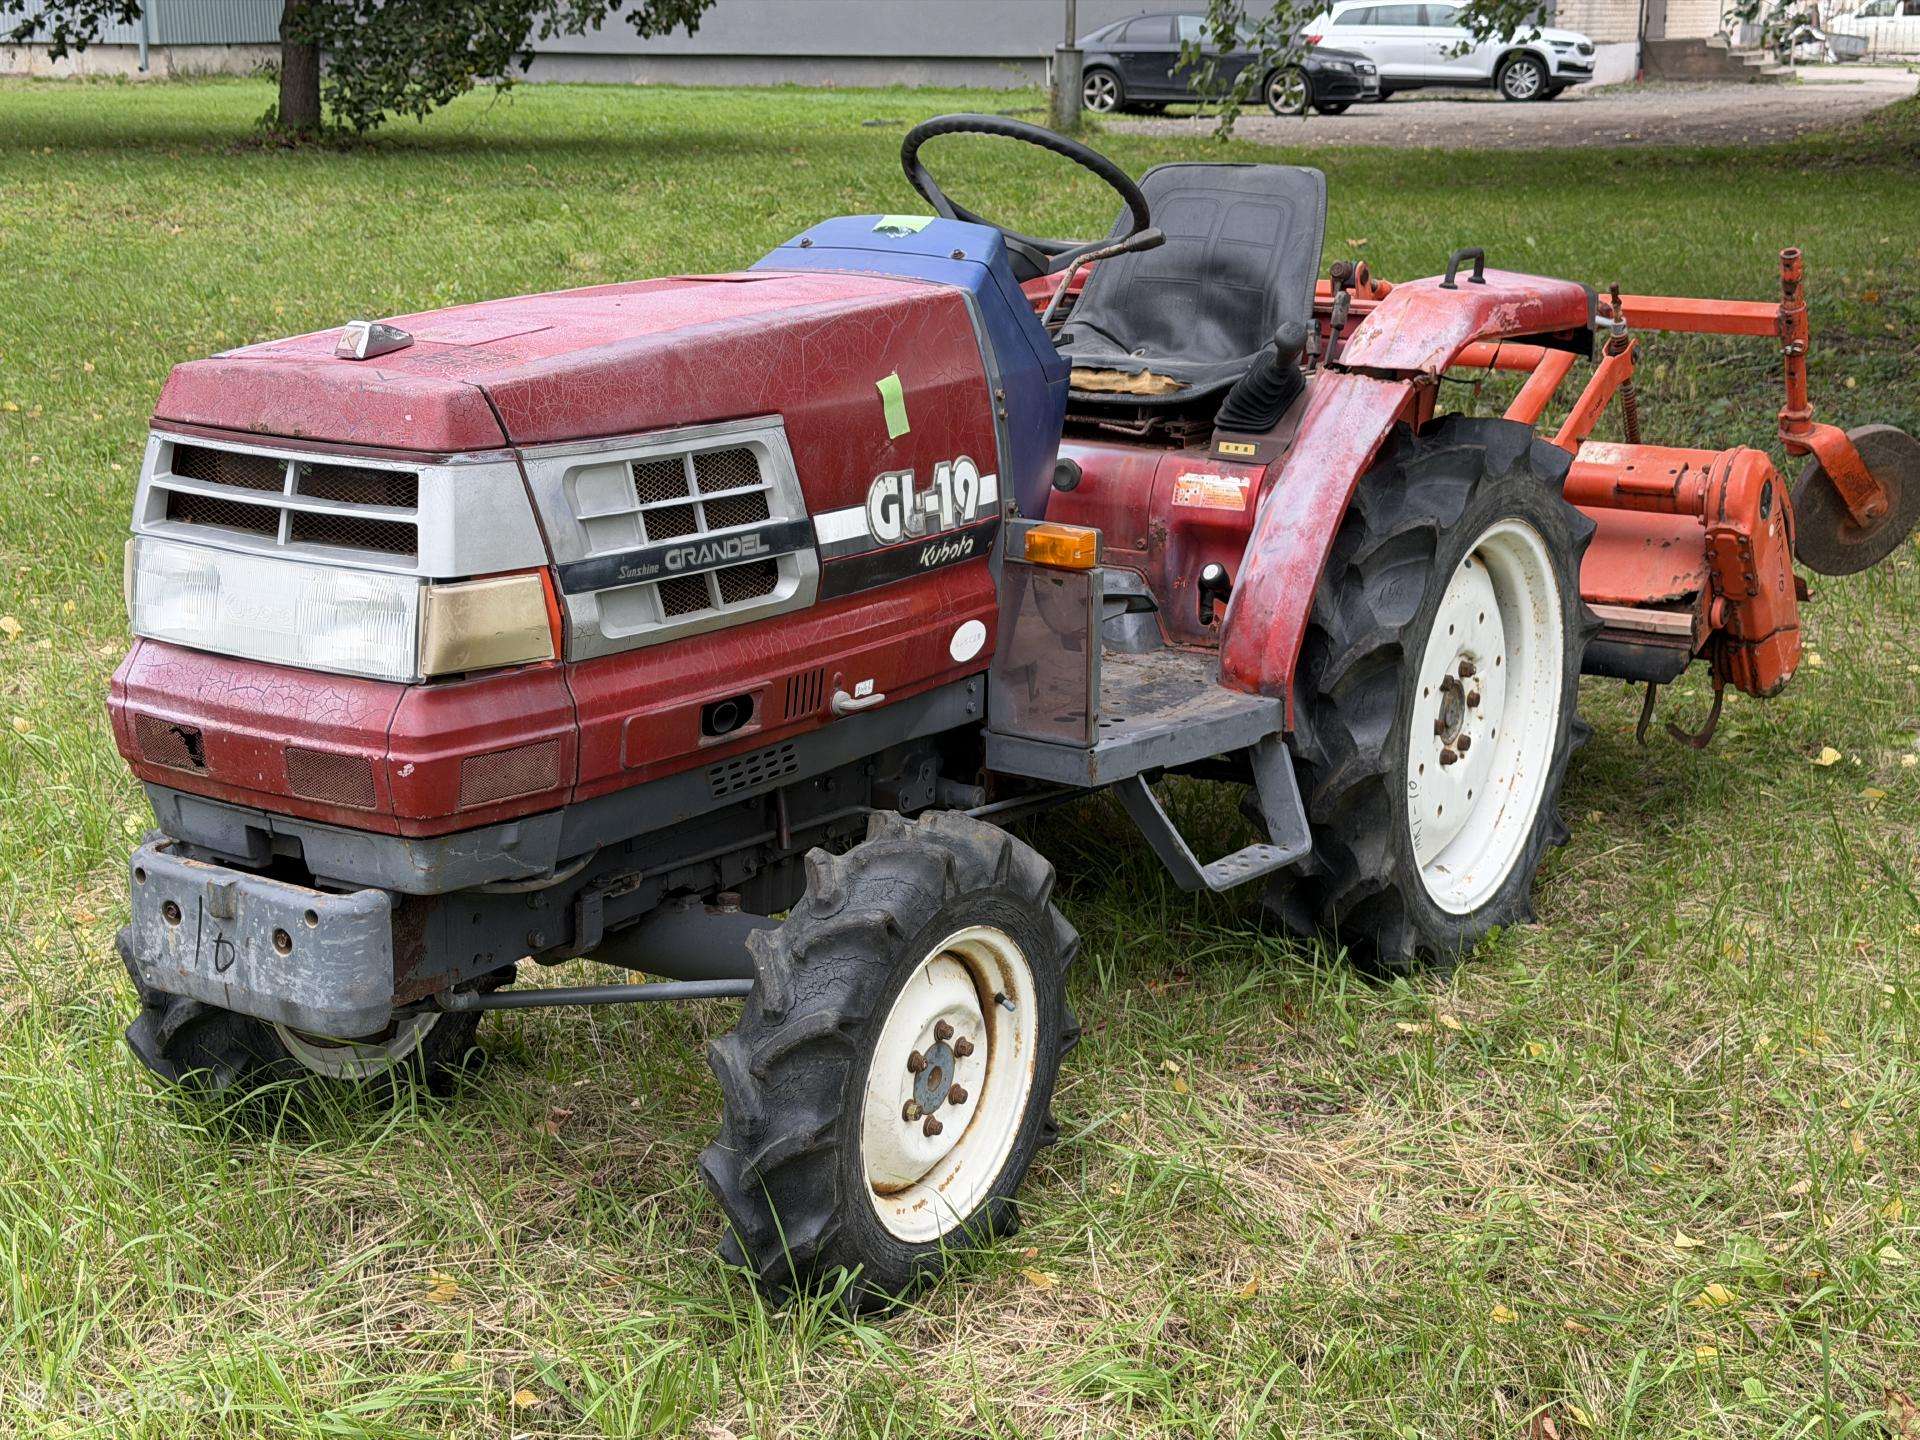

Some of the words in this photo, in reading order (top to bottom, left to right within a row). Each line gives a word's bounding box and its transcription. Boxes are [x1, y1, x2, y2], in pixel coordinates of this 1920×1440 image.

[867, 455, 980, 546] GL-19
[618, 564, 660, 579] Sunshine
[664, 533, 770, 571] GRANDEL
[919, 535, 974, 567] Kubota
